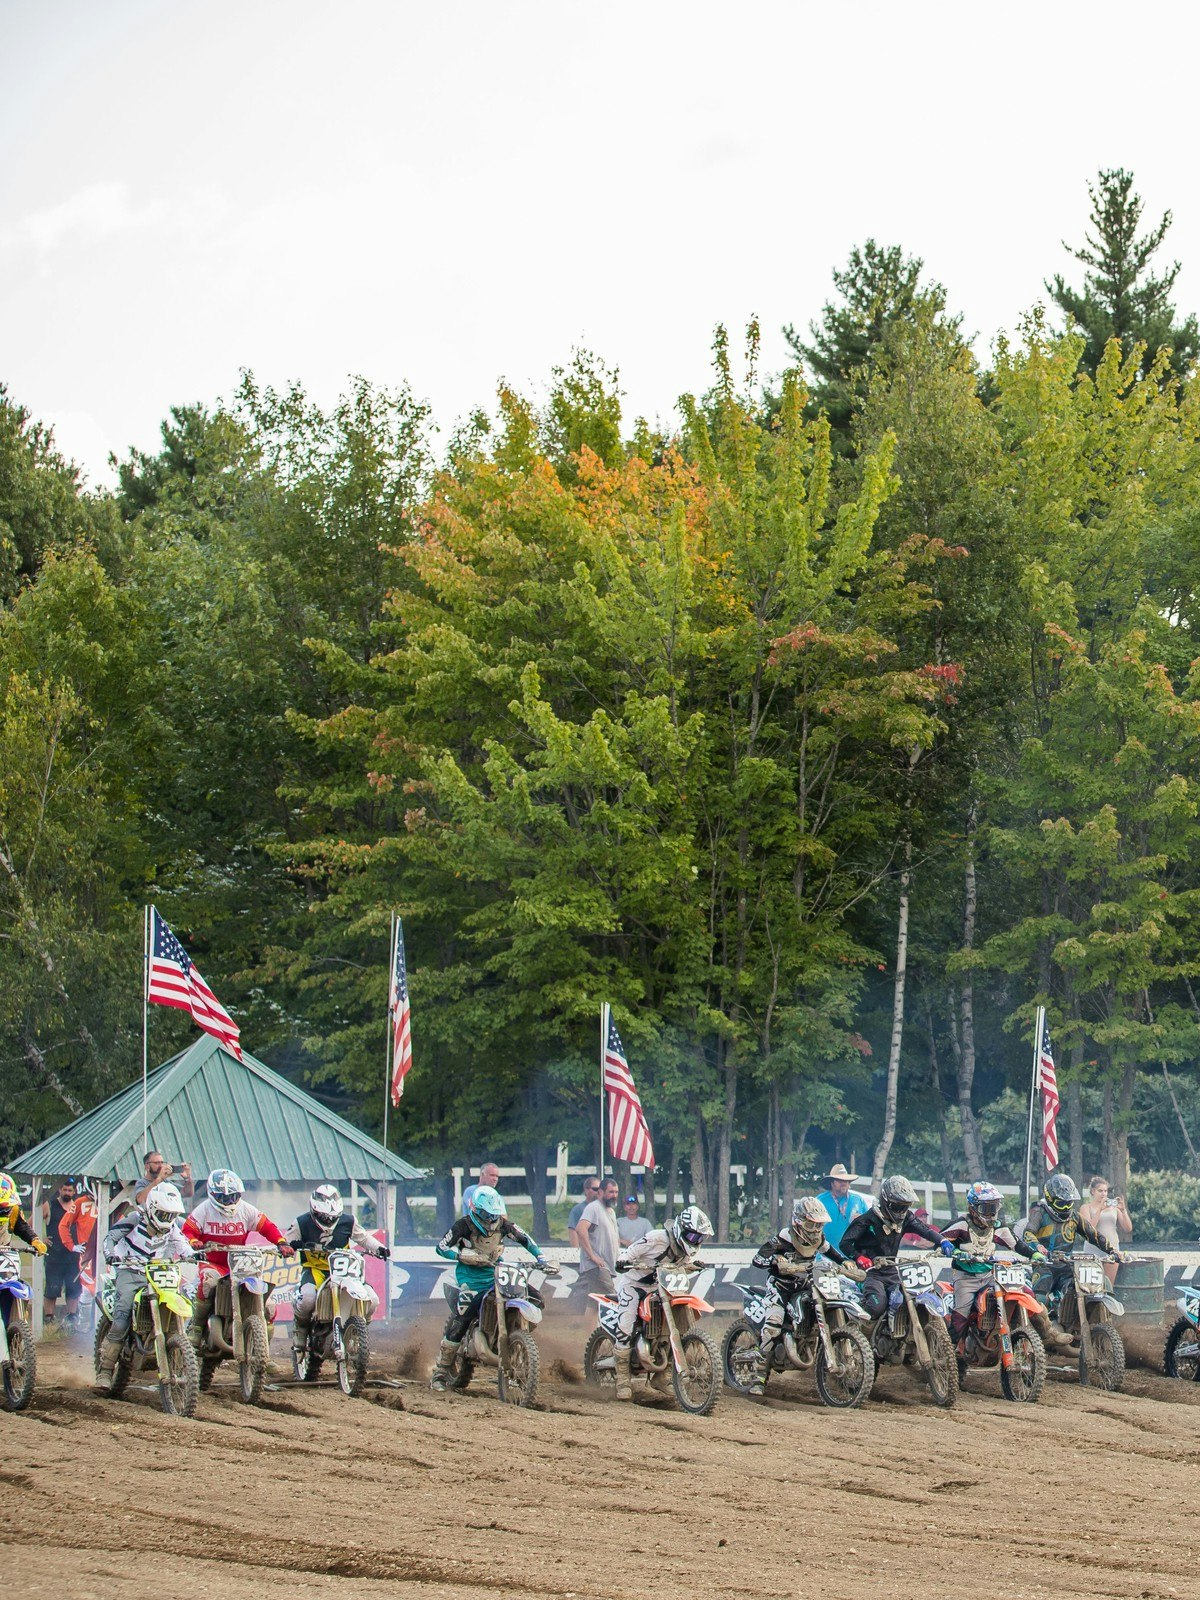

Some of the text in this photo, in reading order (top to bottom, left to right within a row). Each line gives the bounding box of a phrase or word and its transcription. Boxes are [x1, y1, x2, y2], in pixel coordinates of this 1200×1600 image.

[206, 1221, 245, 1234] THOR
[333, 1257, 362, 1278] 94
[902, 1265, 932, 1288] 33
[1078, 1267, 1104, 1284] 115
[153, 1271, 180, 1288] 55
[498, 1267, 528, 1288] 572
[665, 1273, 689, 1292] 22
[819, 1276, 841, 1294] 38
[997, 1270, 1025, 1285] 608
[743, 1300, 767, 1323] 38
